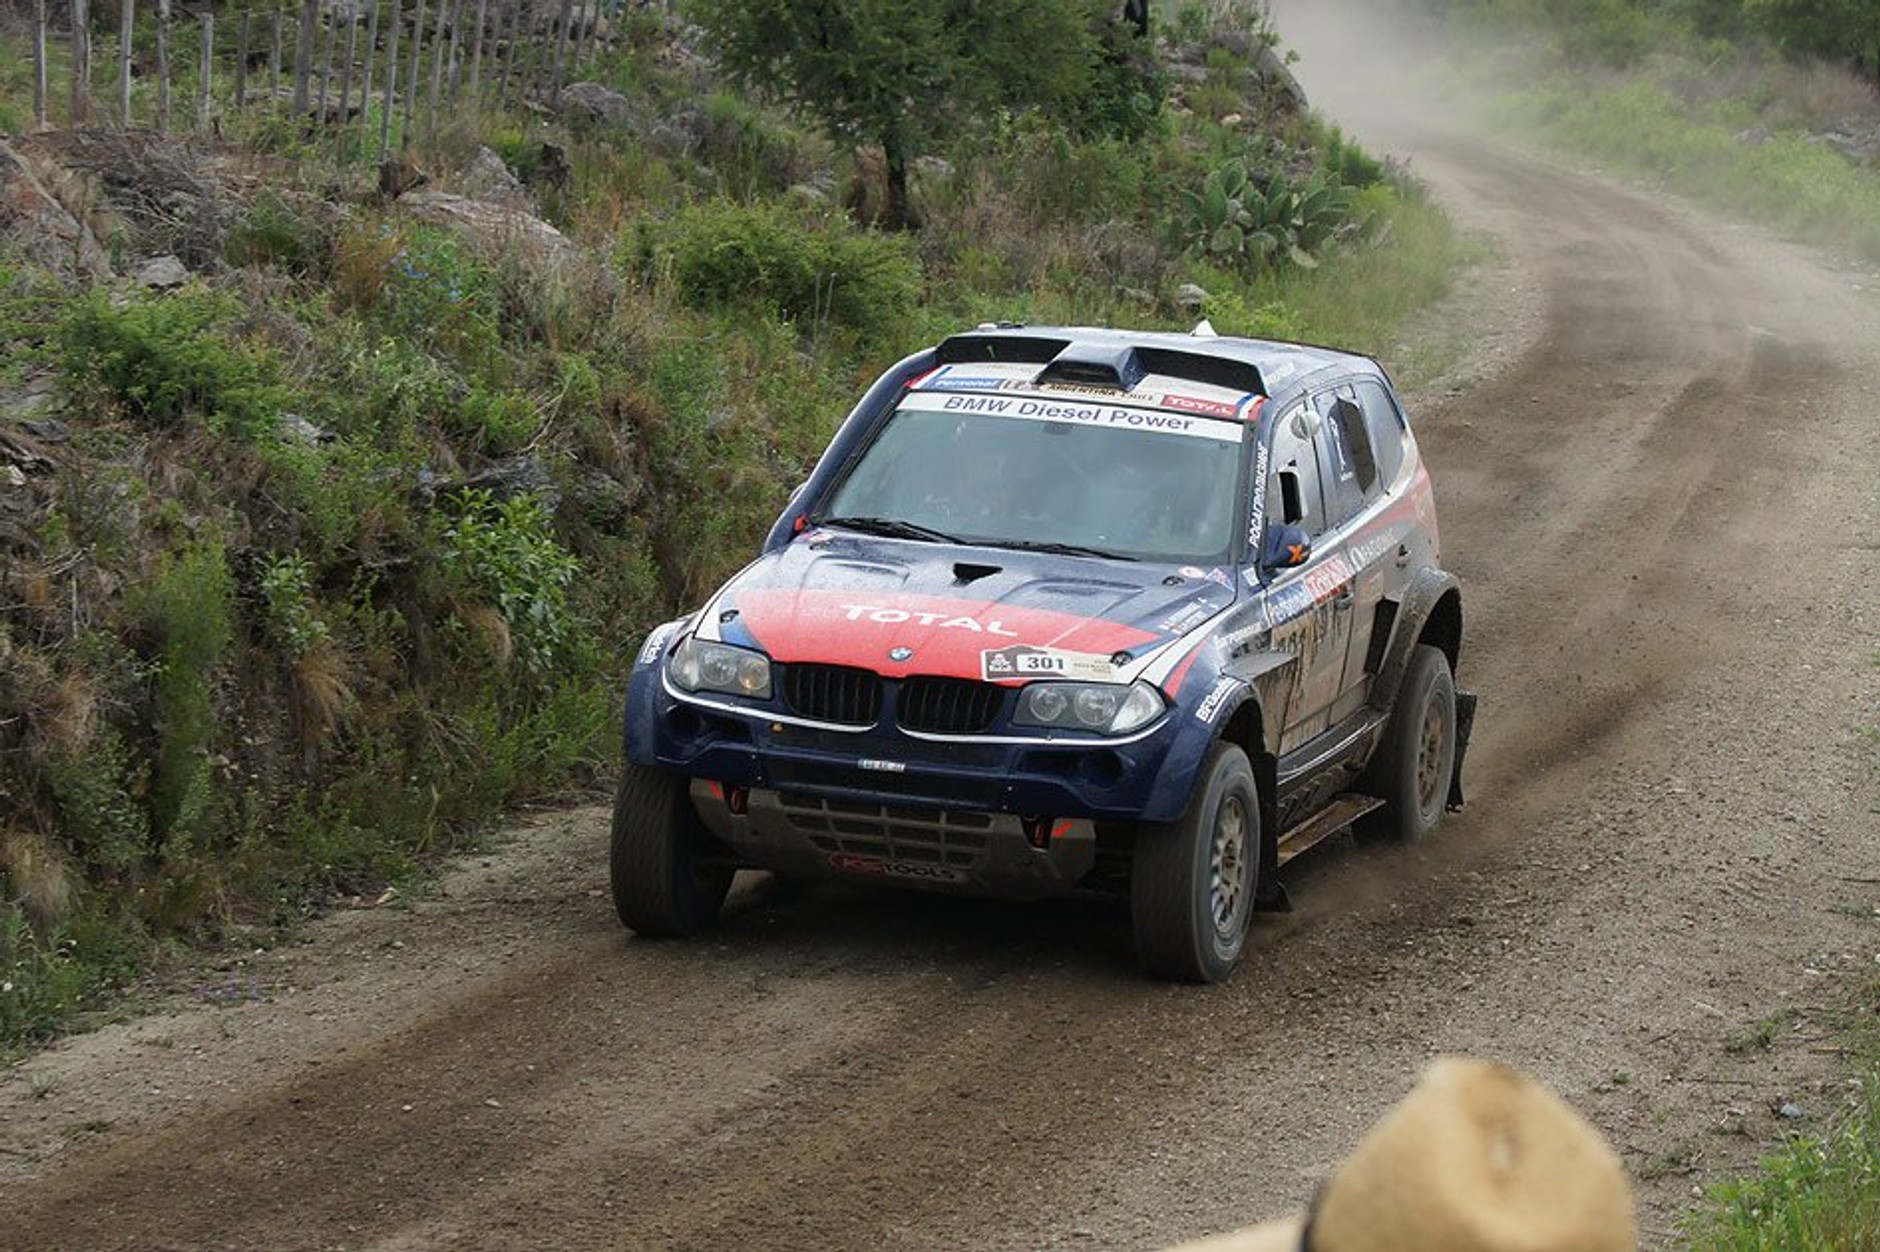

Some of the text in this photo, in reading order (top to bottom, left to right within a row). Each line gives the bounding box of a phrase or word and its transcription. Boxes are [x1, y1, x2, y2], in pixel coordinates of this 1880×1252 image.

[944, 396, 1194, 430] BMW Diesel Power
[1166, 398, 1234, 416] TOTAL
[839, 604, 1019, 637] TOTAL
[1026, 655, 1065, 671] 301
